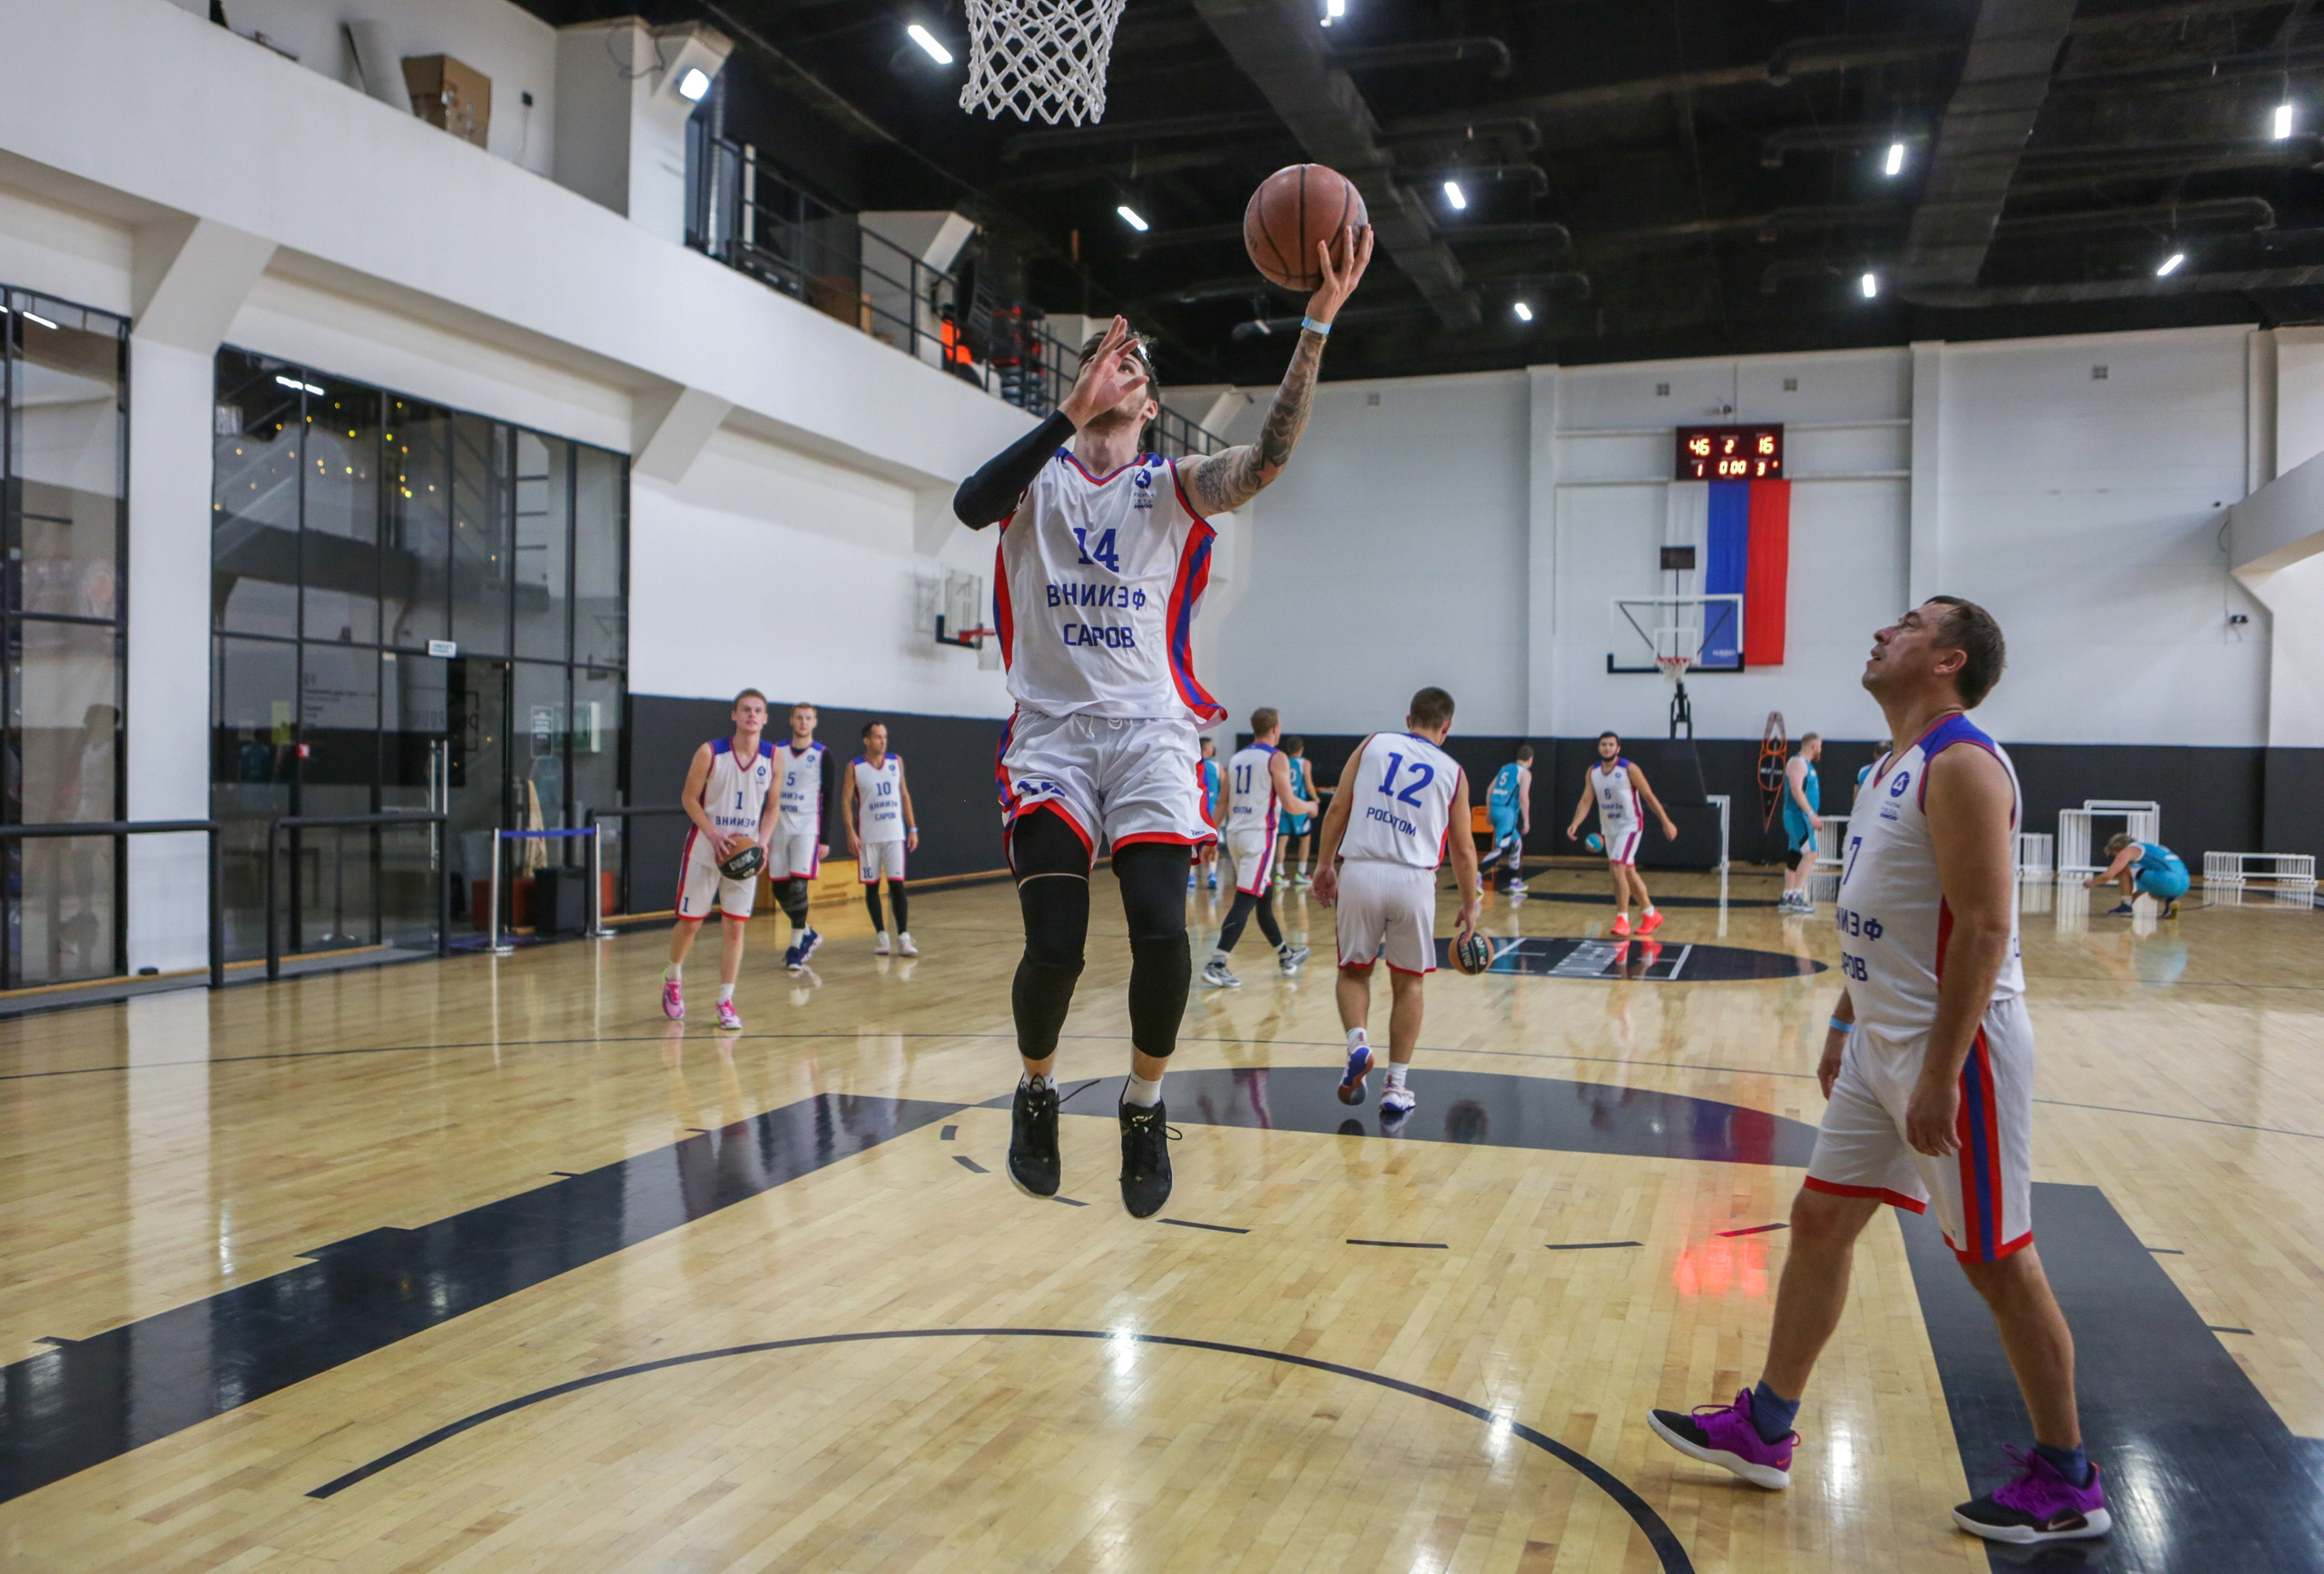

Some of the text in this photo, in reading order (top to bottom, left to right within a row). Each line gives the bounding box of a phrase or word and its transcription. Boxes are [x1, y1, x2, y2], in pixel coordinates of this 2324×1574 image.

[1689, 436, 1774, 456] 46 2 16
[1073, 527, 1119, 573] 14
[1046, 583, 1146, 610] ВНИИЭФ
[1063, 623, 1135, 648] САРОВ
[786, 772, 796, 786] 5
[876, 782, 891, 796] 10
[1236, 764, 1252, 794] 11
[1378, 752, 1434, 809] 12
[735, 792, 743, 810] 1
[780, 804, 798, 812] АРОВ
[715, 815, 755, 827] ВНИИЭФ
[1843, 837, 1863, 885] 7
[682, 896, 689, 912] 1
